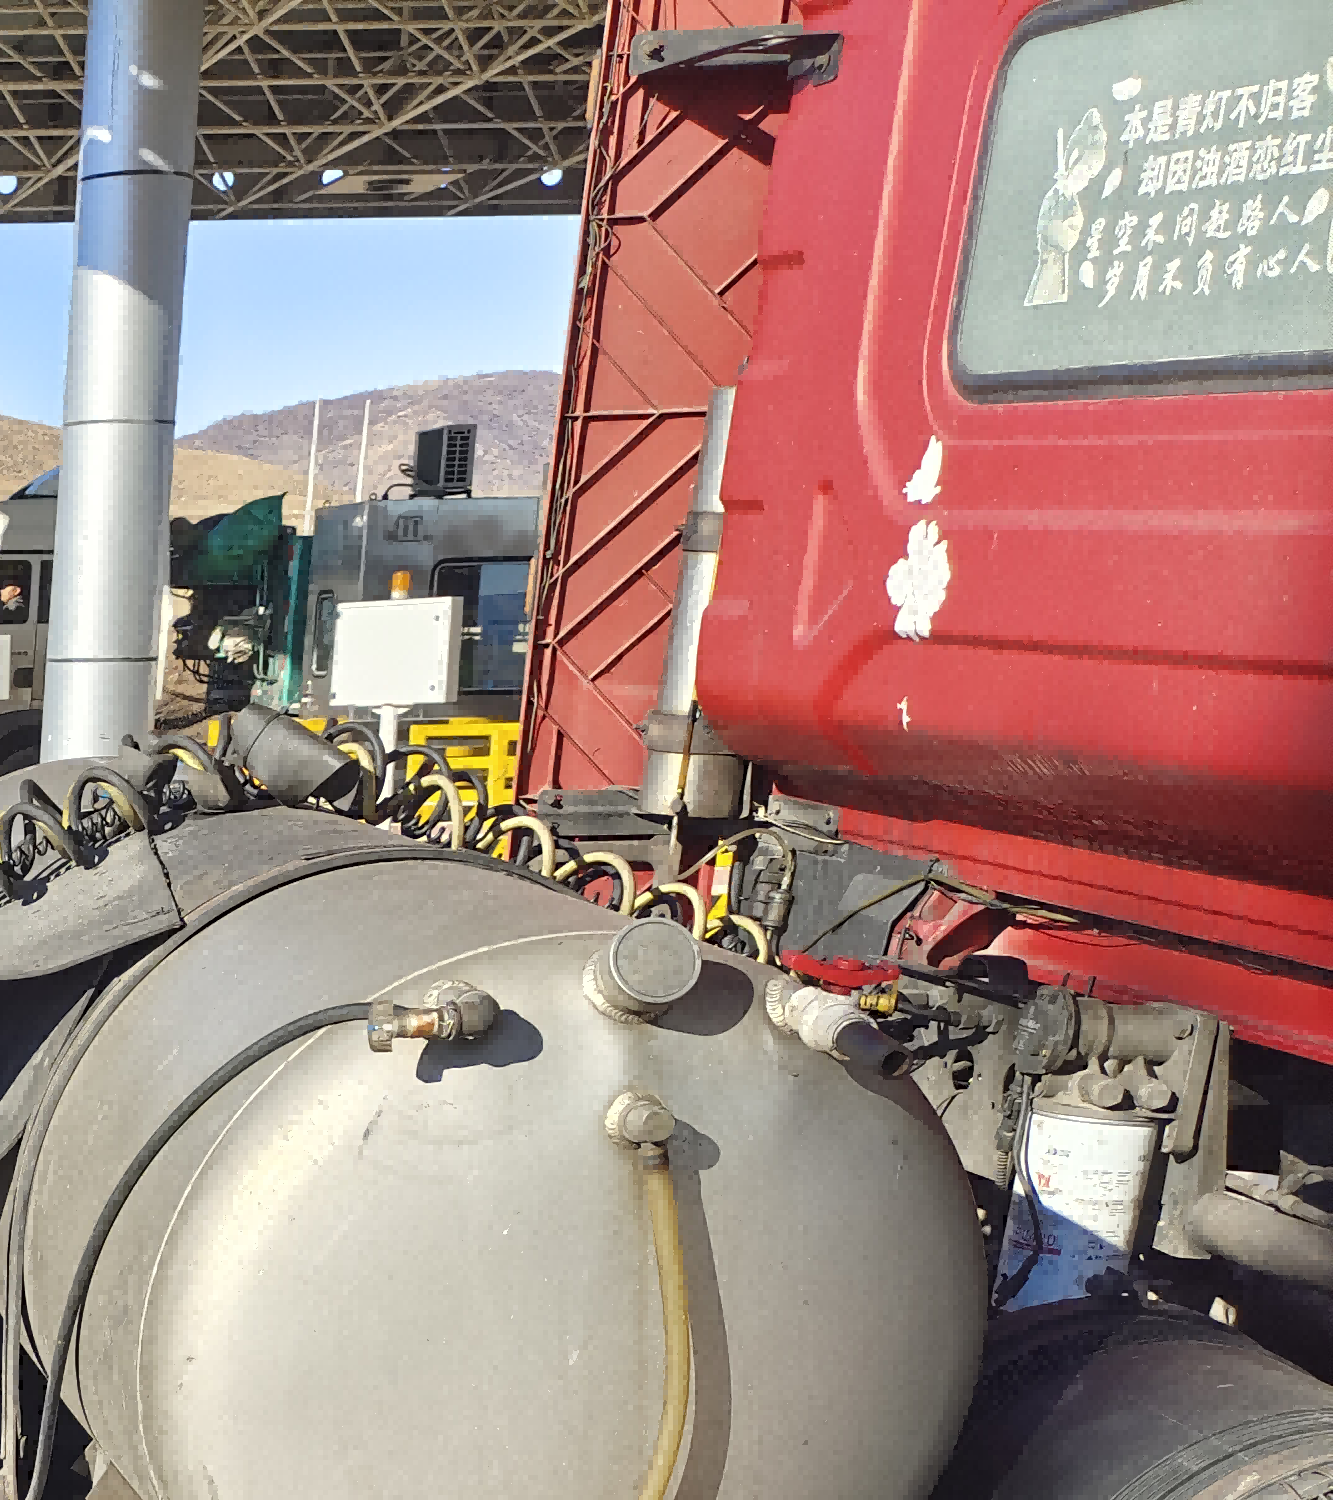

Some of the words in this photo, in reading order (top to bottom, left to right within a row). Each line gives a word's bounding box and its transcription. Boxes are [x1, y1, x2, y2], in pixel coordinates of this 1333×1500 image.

[1120, 71, 1320, 149] 本是青灯不归客
[1086, 194, 1300, 260] 星空不问赶路人
[1098, 243, 1322, 308] 岁月不负有心人
